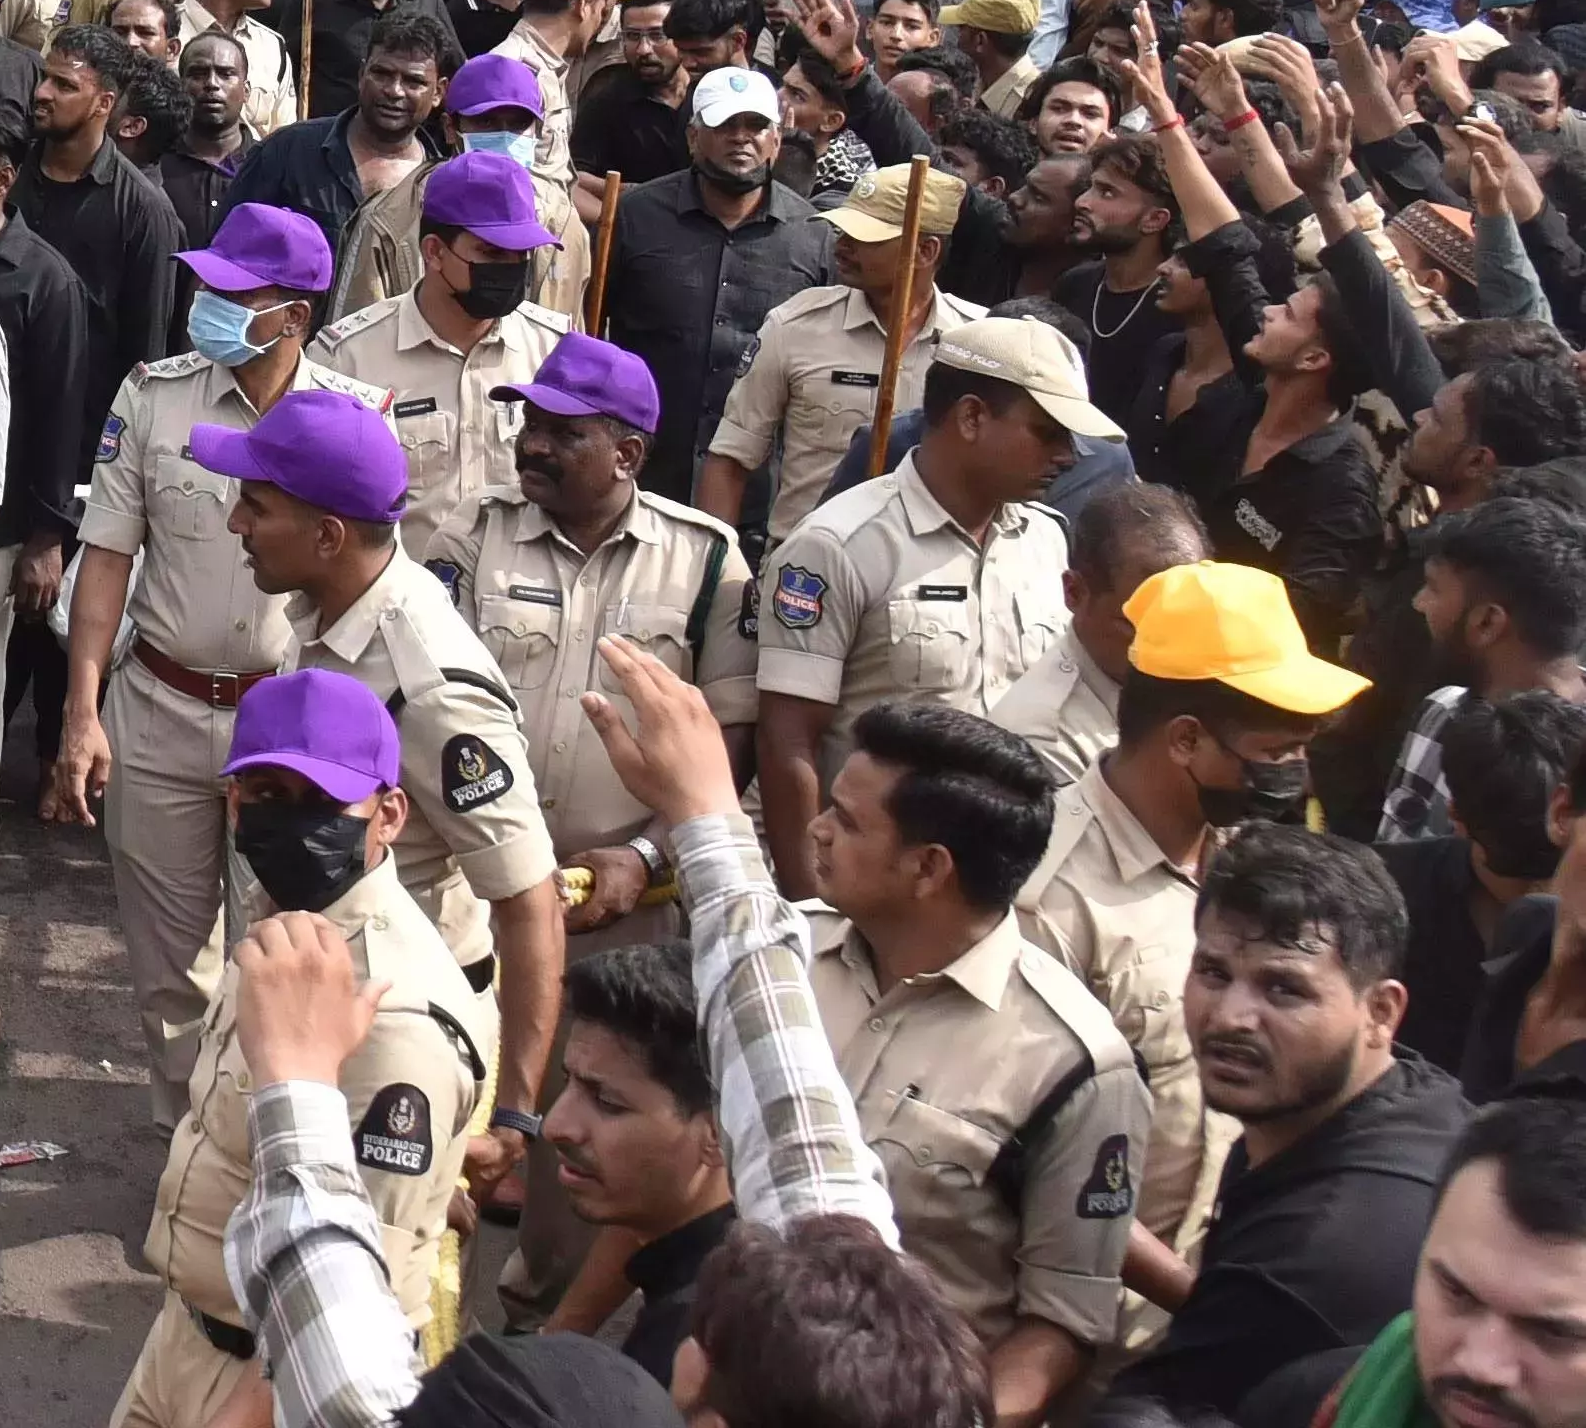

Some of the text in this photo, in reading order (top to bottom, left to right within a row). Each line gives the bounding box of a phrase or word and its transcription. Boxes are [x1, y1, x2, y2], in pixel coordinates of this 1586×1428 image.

[778, 592, 818, 612] POLICE
[455, 775, 506, 806] POLICE
[363, 1133, 425, 1154] HYDERABAD CITY
[364, 1143, 422, 1170] POLICE
